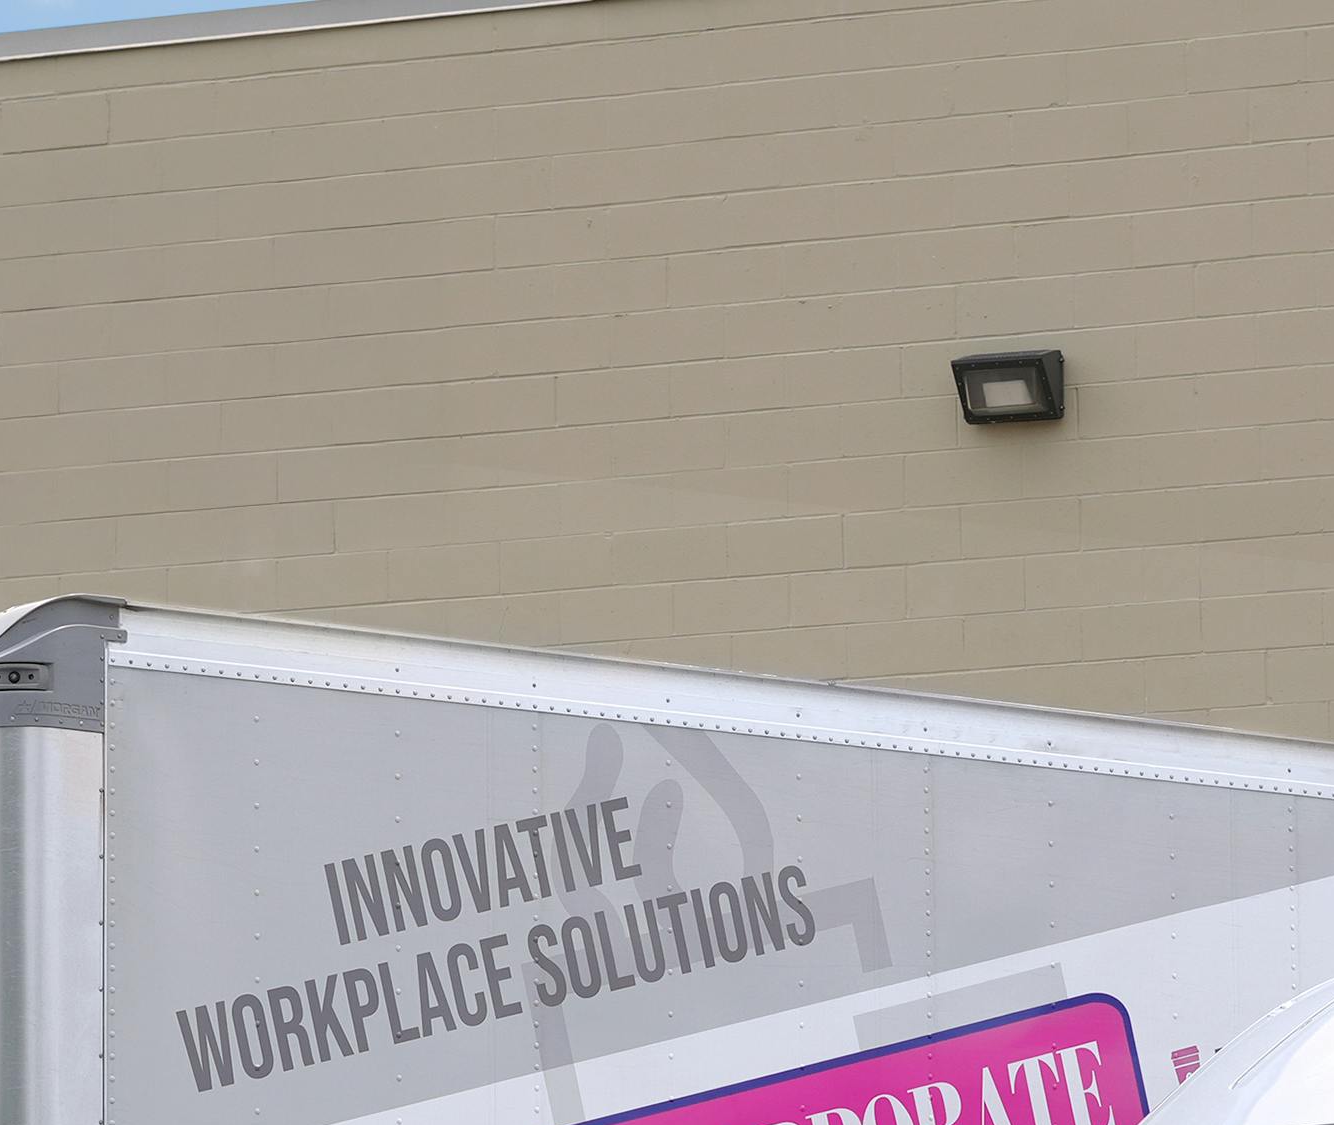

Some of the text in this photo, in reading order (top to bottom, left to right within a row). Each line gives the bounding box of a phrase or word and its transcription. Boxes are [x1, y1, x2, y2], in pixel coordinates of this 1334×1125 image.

[323, 796, 642, 946] INNOVATIVE
[176, 865, 817, 1093] WORKPLACE SOLUTIONS
